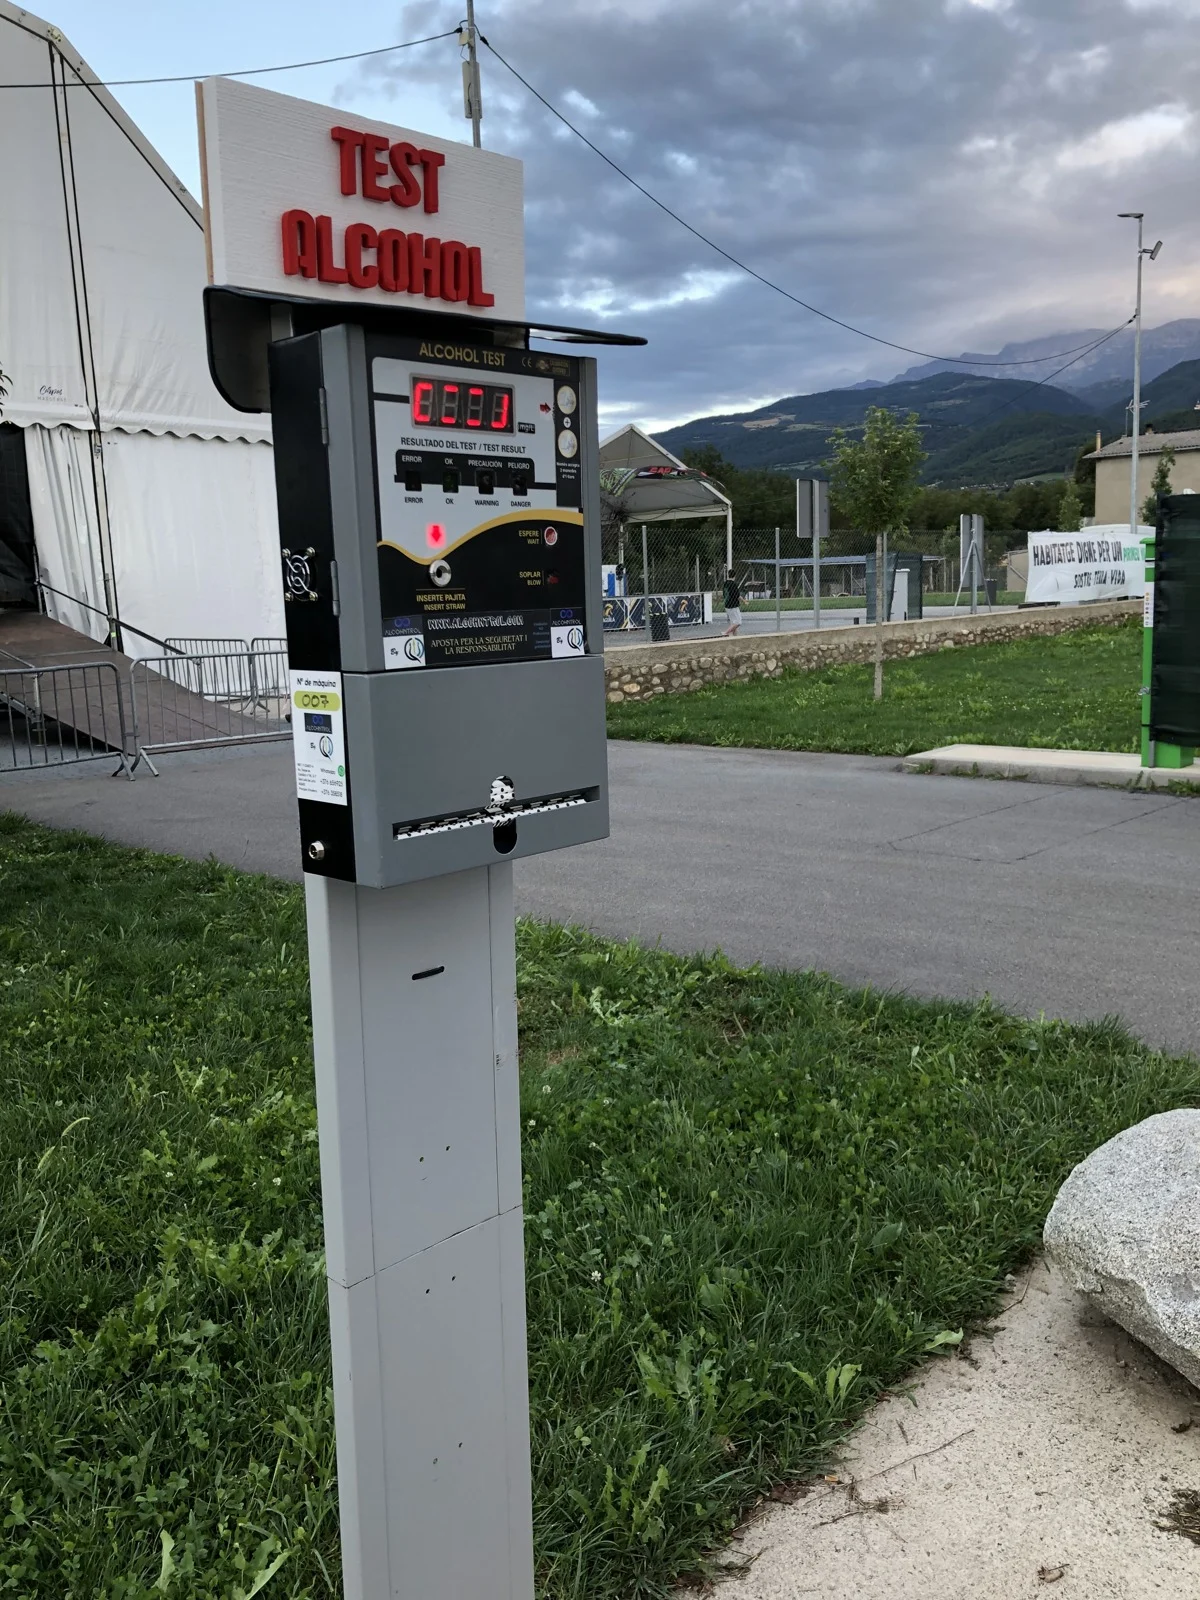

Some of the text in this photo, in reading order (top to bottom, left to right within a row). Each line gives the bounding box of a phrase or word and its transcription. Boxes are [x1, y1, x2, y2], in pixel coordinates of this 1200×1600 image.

[331, 126, 445, 214] TEST
[282, 208, 494, 307] ALCOHOL
[419, 342, 506, 366] ALCOHOL TEST
[401, 436, 444, 448] RESULTADO
[445, 440, 460, 449] DEL
[460, 442, 477, 451] TEST
[483, 444, 500, 452] TEST
[502, 445, 526, 454] RESULT
[402, 455, 422, 463] ERROR
[508, 462, 530, 470] PELIGRO
[405, 496, 424, 504] ERROR
[475, 499, 499, 507] WARNING
[1033, 542, 1075, 566] HABITATGE
[1076, 541, 1097, 564] DIGNE
[1097, 540, 1111, 563] PER
[1110, 569, 1126, 585] VIDA
[416, 593, 466, 602] INSERTE PAJITA
[424, 603, 445, 611] INSERT
[430, 637, 460, 648] APOSTA
[460, 637, 474, 646] PER
[475, 636, 485, 645] LA
[485, 634, 523, 644] SEGURETAT
[445, 643, 515, 655] LA RESPONSABILITAT
[305, 678, 311, 686] de
[302, 693, 329, 708] 007
